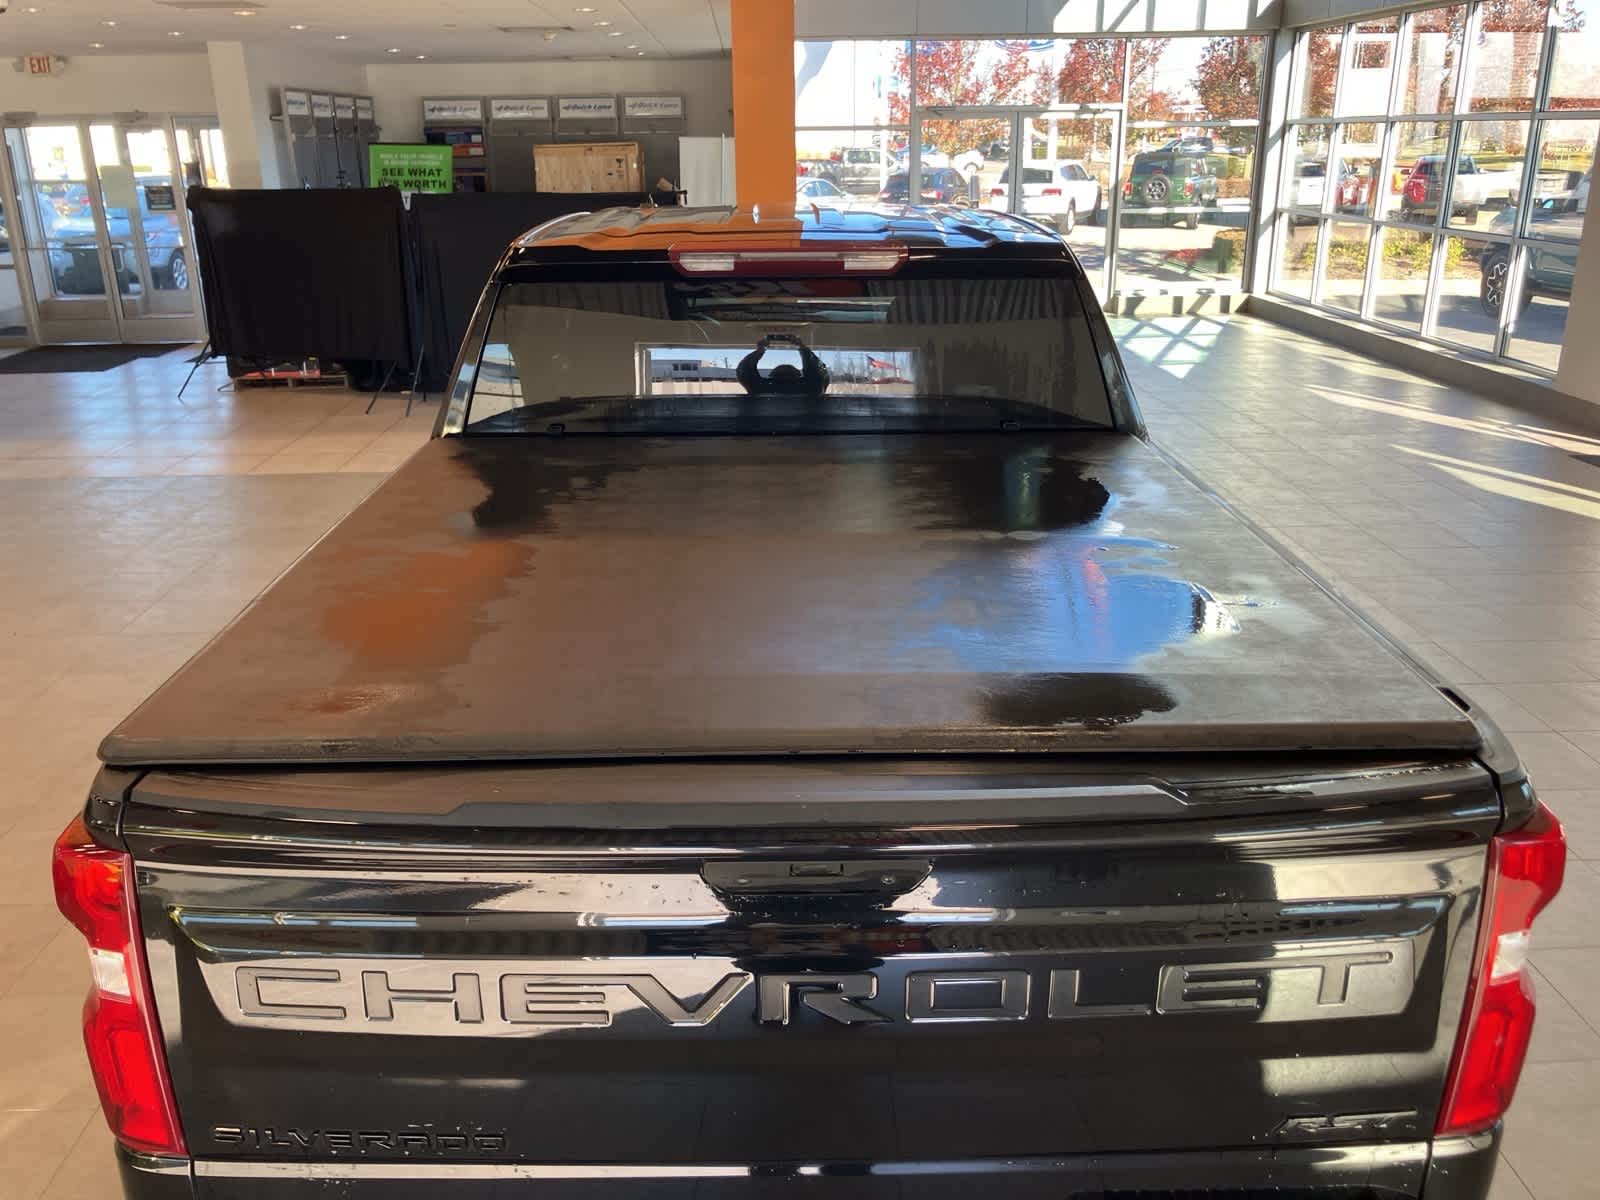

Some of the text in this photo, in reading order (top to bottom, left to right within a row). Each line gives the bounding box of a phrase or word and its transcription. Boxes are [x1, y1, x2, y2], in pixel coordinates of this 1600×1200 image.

[382, 168, 443, 177] SEE WHAT
[403, 179, 447, 189] WORTH
[234, 951, 1394, 1026] CHEVROLET
[214, 1126, 507, 1151] SILVERADO
